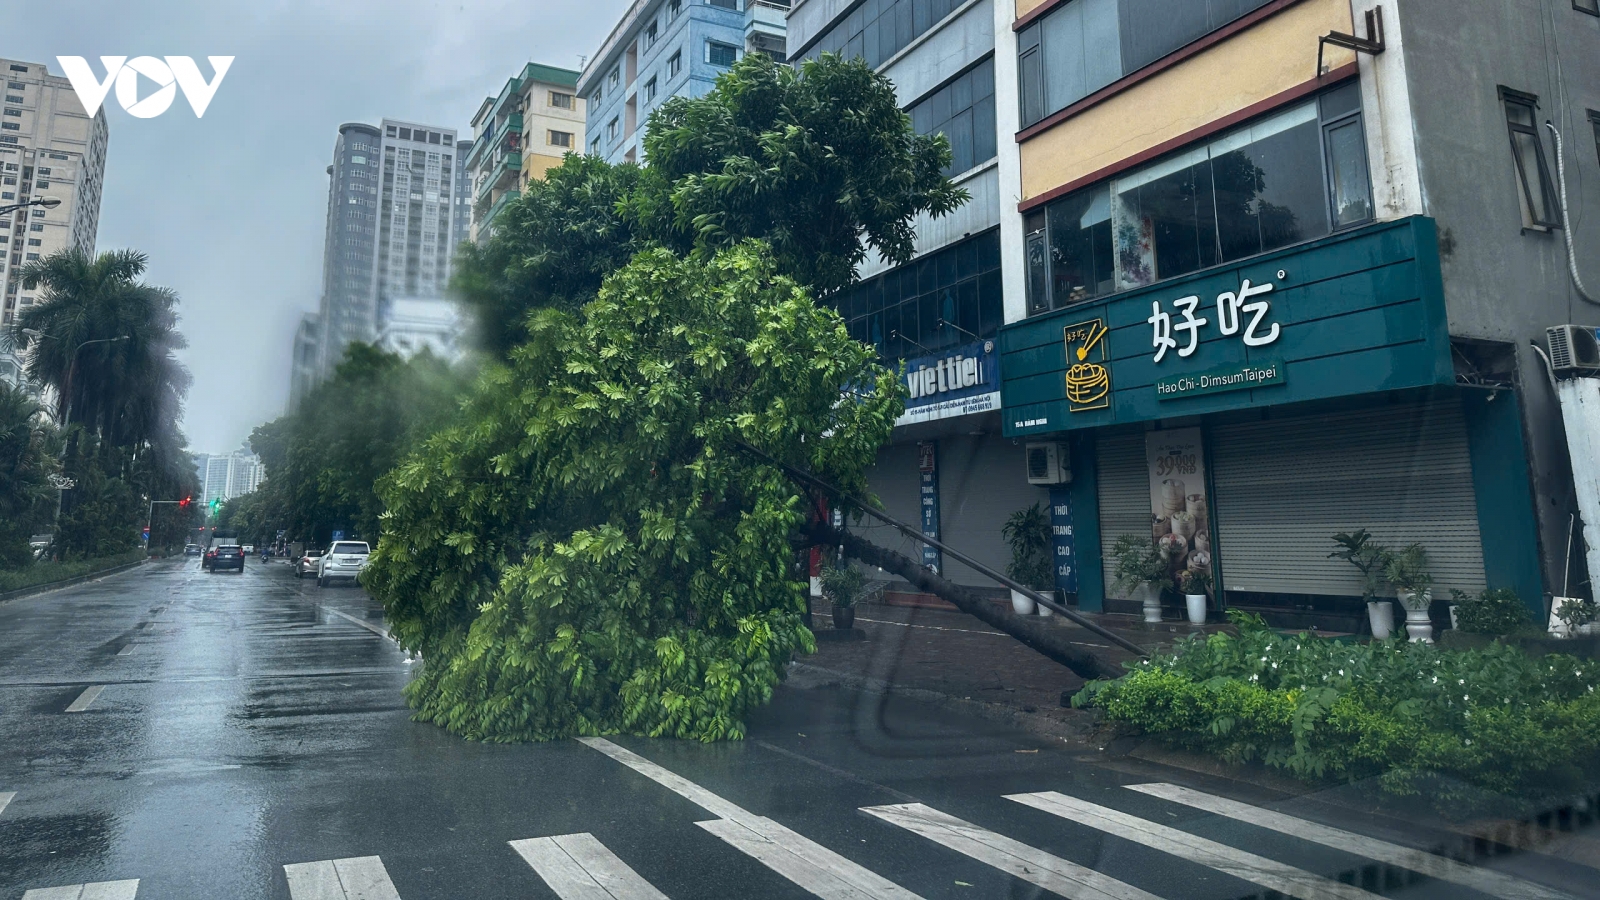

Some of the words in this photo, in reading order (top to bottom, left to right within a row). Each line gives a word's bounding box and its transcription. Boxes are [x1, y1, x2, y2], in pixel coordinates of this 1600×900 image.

[1148, 279, 1280, 363] 好吃
[1054, 503, 1068, 516] THỜI
[1052, 525, 1072, 536] TRANG
[1057, 545, 1070, 556] CAO
[1058, 562, 1071, 576] CẤP
